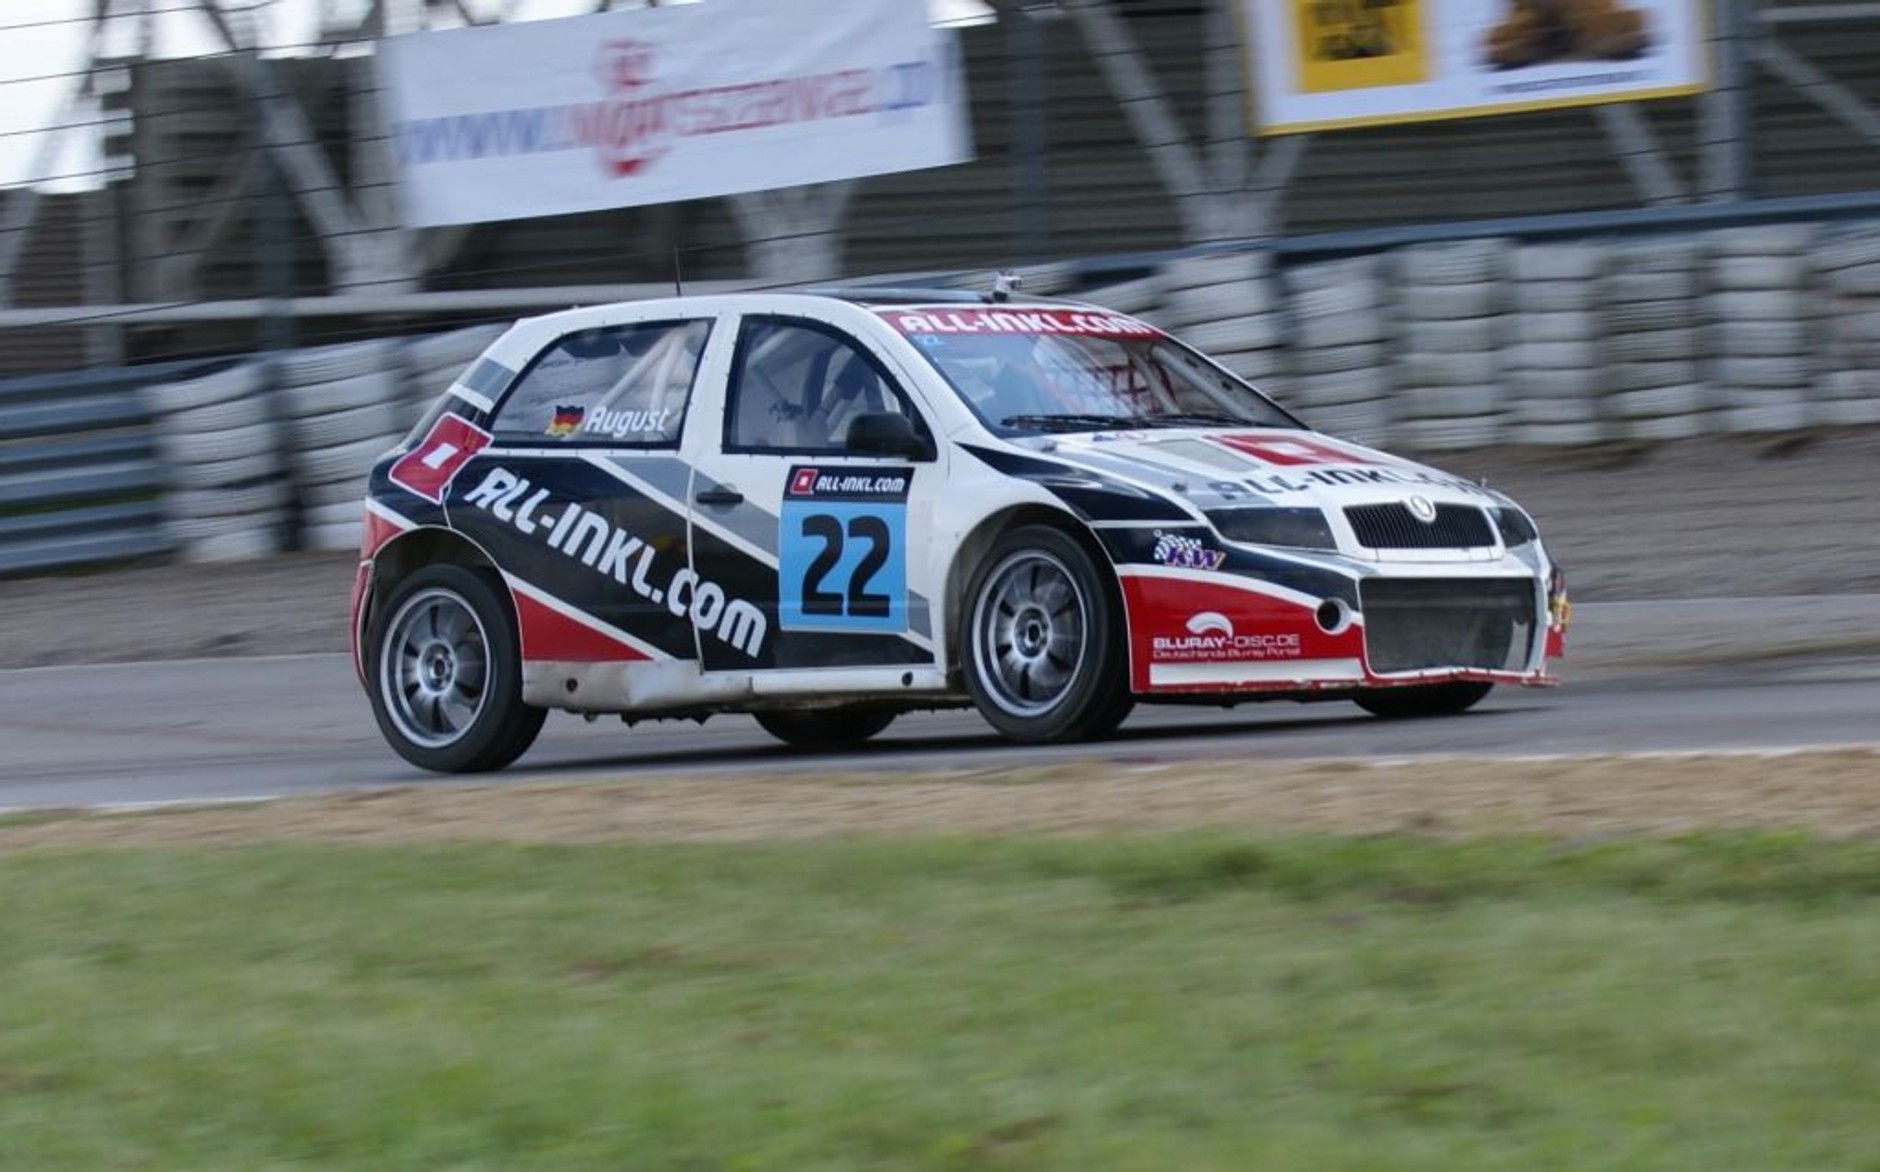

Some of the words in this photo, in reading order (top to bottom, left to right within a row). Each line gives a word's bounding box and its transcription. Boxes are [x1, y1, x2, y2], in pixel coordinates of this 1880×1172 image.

[585, 406, 670, 438] August
[800, 513, 891, 618] 22
[1164, 546, 1226, 571] KW
